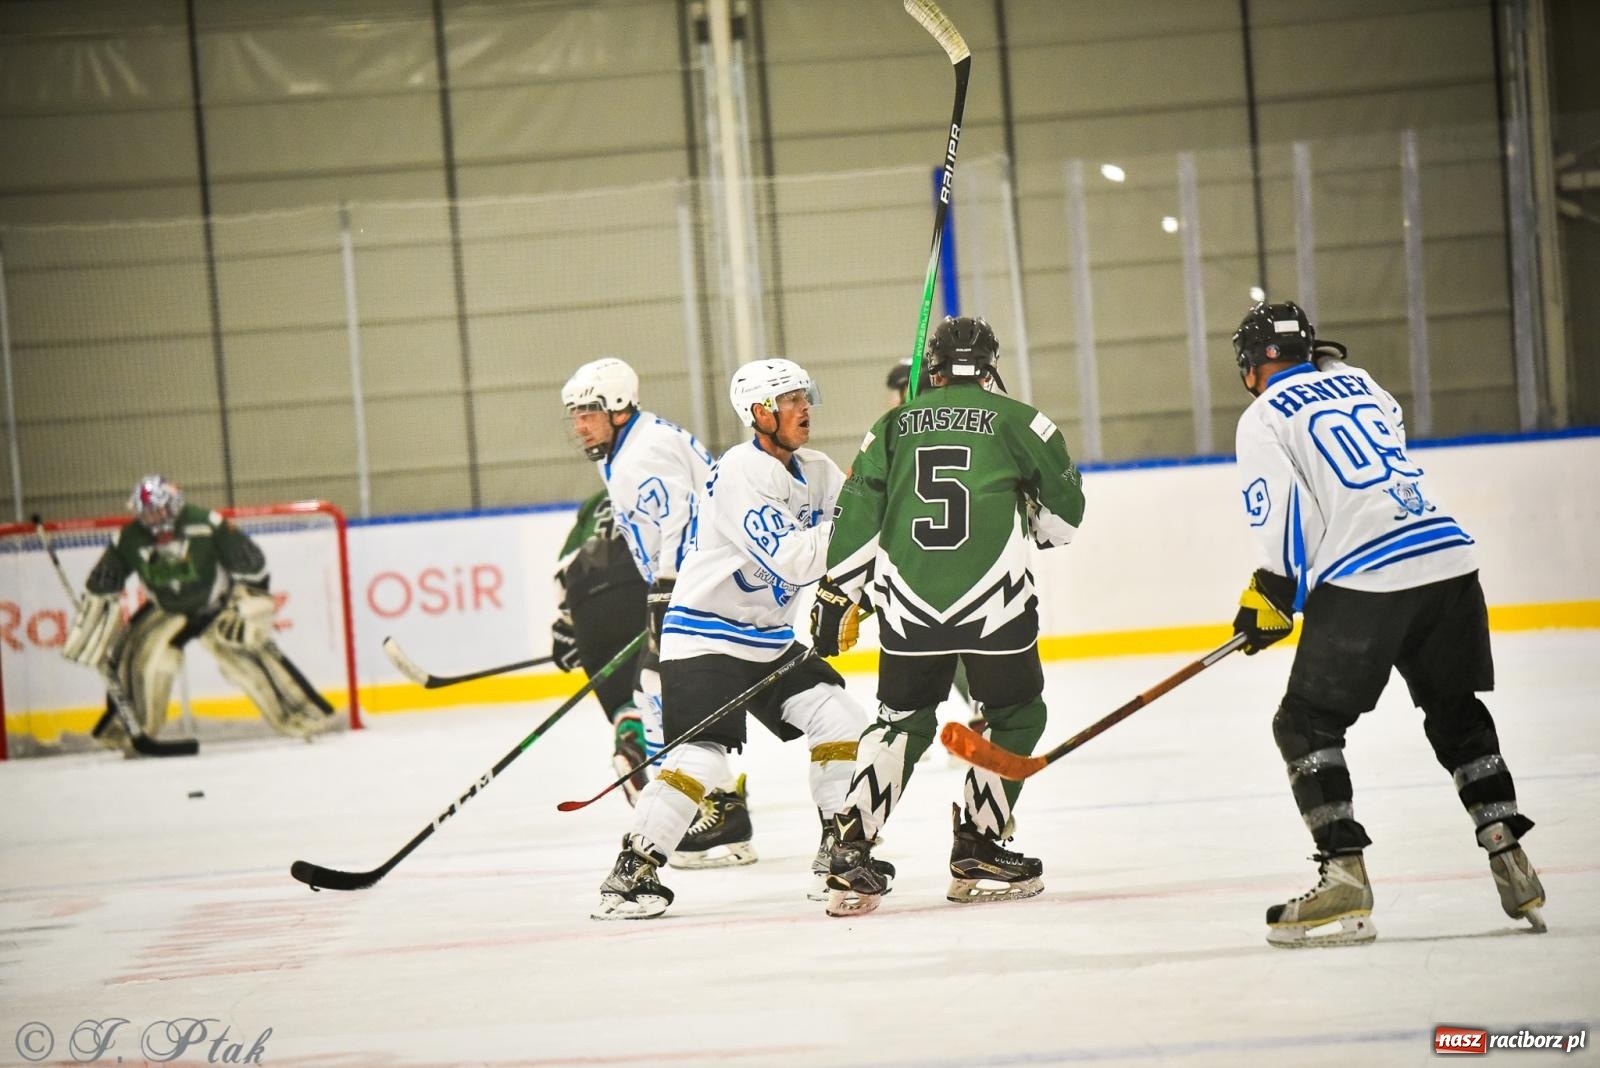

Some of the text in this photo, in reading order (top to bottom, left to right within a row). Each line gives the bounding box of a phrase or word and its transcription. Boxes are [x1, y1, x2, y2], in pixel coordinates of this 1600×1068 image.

[898, 407, 998, 437] STASZEK
[911, 445, 972, 551] 5
[1242, 477, 1271, 527] 9
[367, 564, 504, 619] OSiR
